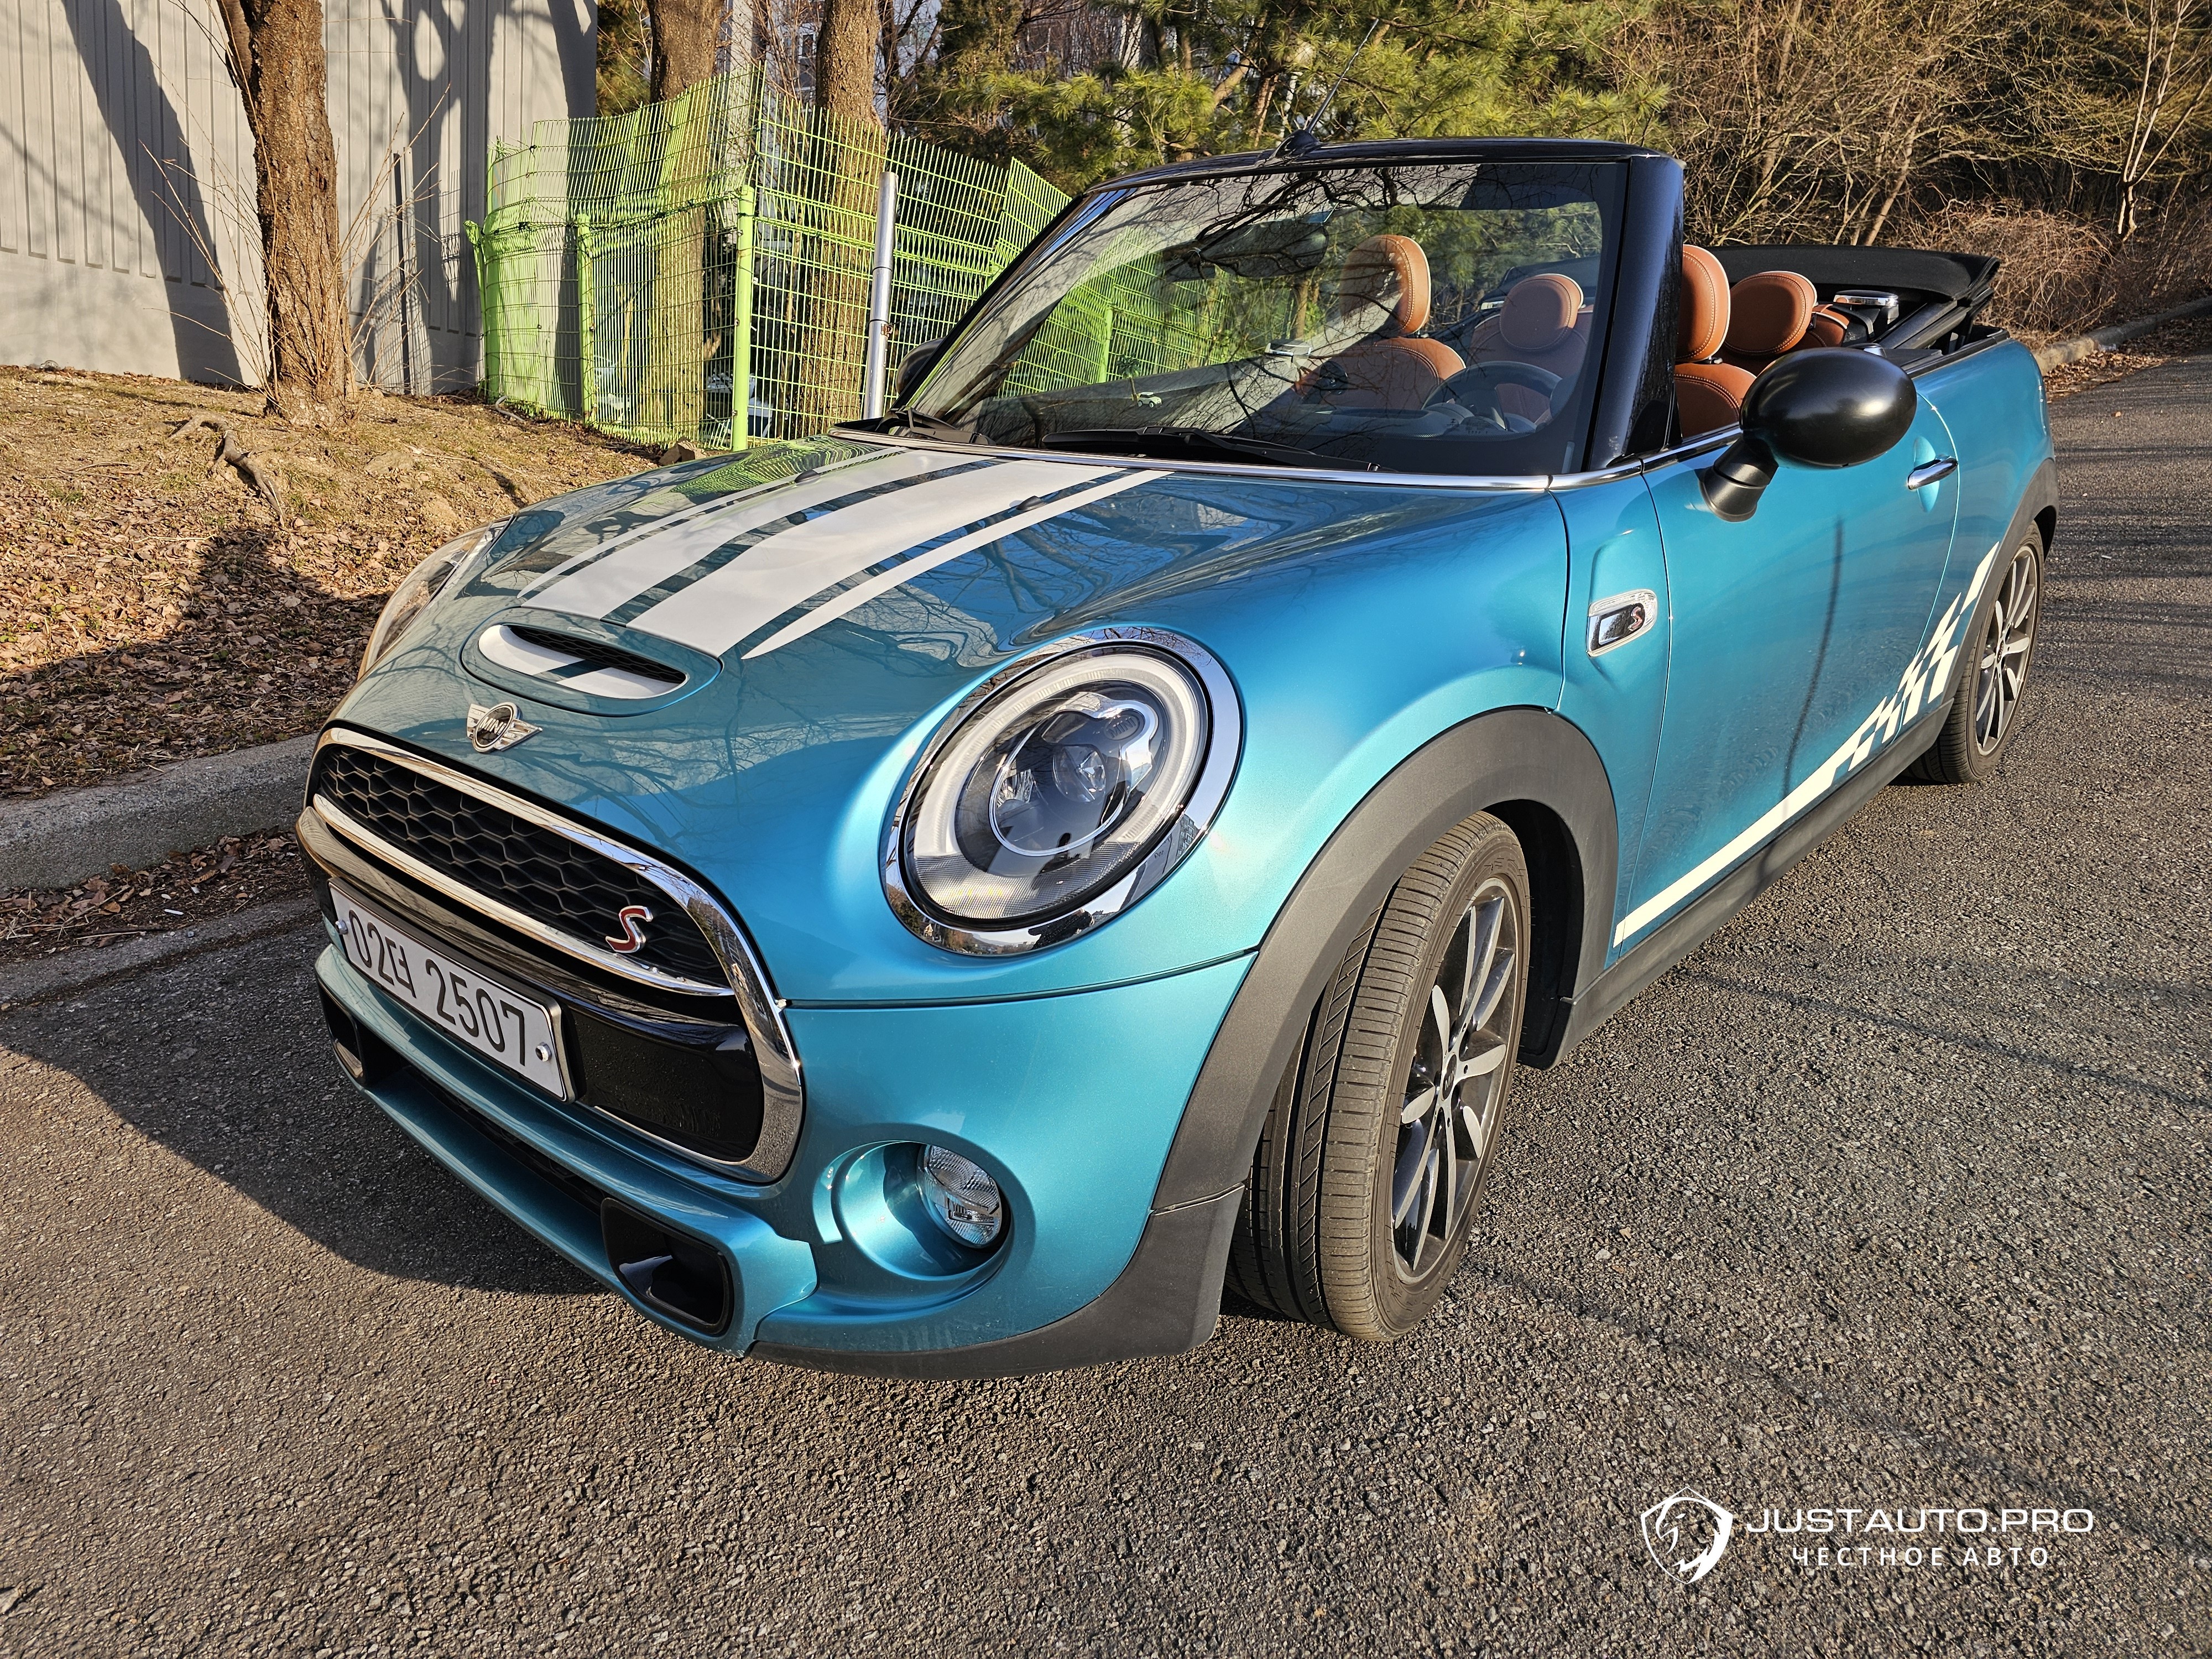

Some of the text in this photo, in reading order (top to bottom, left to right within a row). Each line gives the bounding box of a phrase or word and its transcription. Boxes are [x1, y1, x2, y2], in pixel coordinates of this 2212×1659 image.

[479, 716, 507, 736] MINI
[1106, 717, 1136, 739] MINI
[605, 905, 654, 953] S
[348, 910, 525, 1067] 02더 2507
